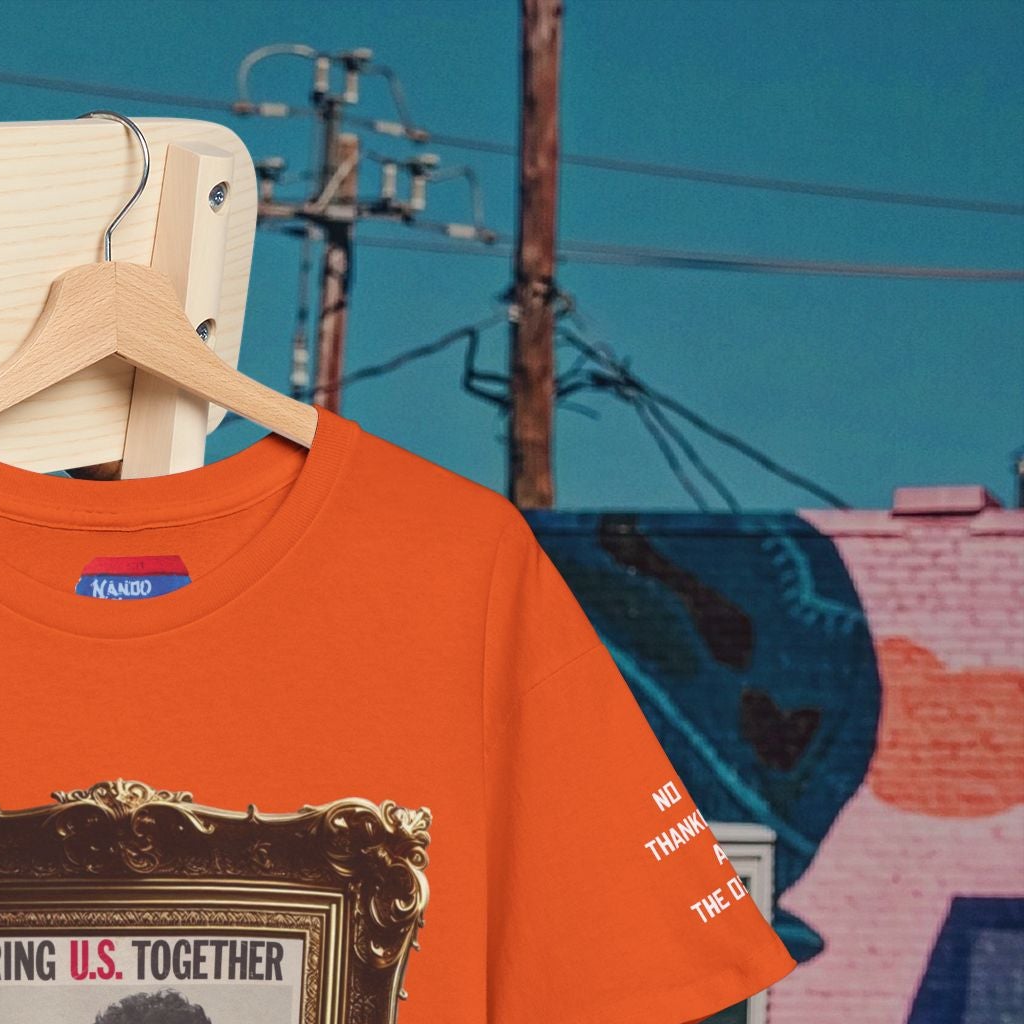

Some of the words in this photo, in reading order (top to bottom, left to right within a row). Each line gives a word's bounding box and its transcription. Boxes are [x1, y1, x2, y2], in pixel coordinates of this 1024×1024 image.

[91, 579, 152, 598] NANDO
[651, 781, 682, 812] NO
[689, 888, 731, 923] THE
[726, 875, 749, 901] O
[70, 939, 123, 980] U.S.
[131, 940, 284, 981] TOGETHER
